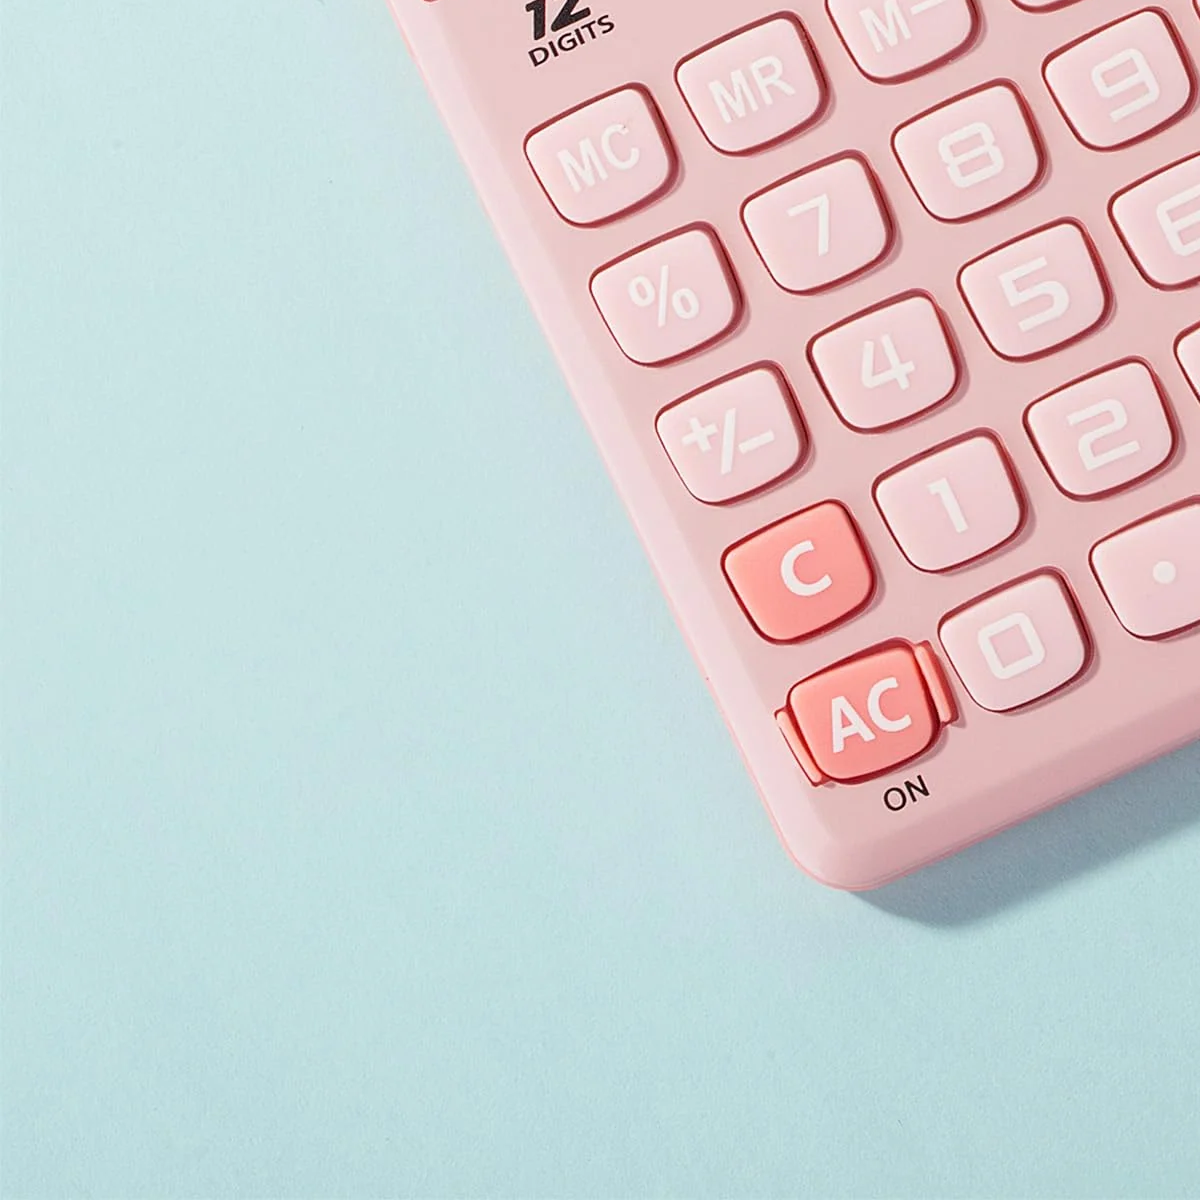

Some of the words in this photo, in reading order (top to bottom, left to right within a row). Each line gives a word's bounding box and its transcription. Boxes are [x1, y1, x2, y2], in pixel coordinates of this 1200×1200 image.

[527, 14, 615, 68] DIGITS
[708, 55, 796, 125] MR
[1091, 47, 1161, 123] 9
[556, 122, 640, 193] MC
[937, 121, 1005, 189] 8
[786, 193, 831, 257] 7
[627, 264, 700, 328] %
[996, 256, 1069, 332] 5
[859, 332, 916, 392] 4
[1066, 397, 1140, 471] 2
[927, 476, 969, 534] 1
[779, 540, 833, 597] C
[829, 676, 913, 754] AC
[882, 774, 931, 813] ON
